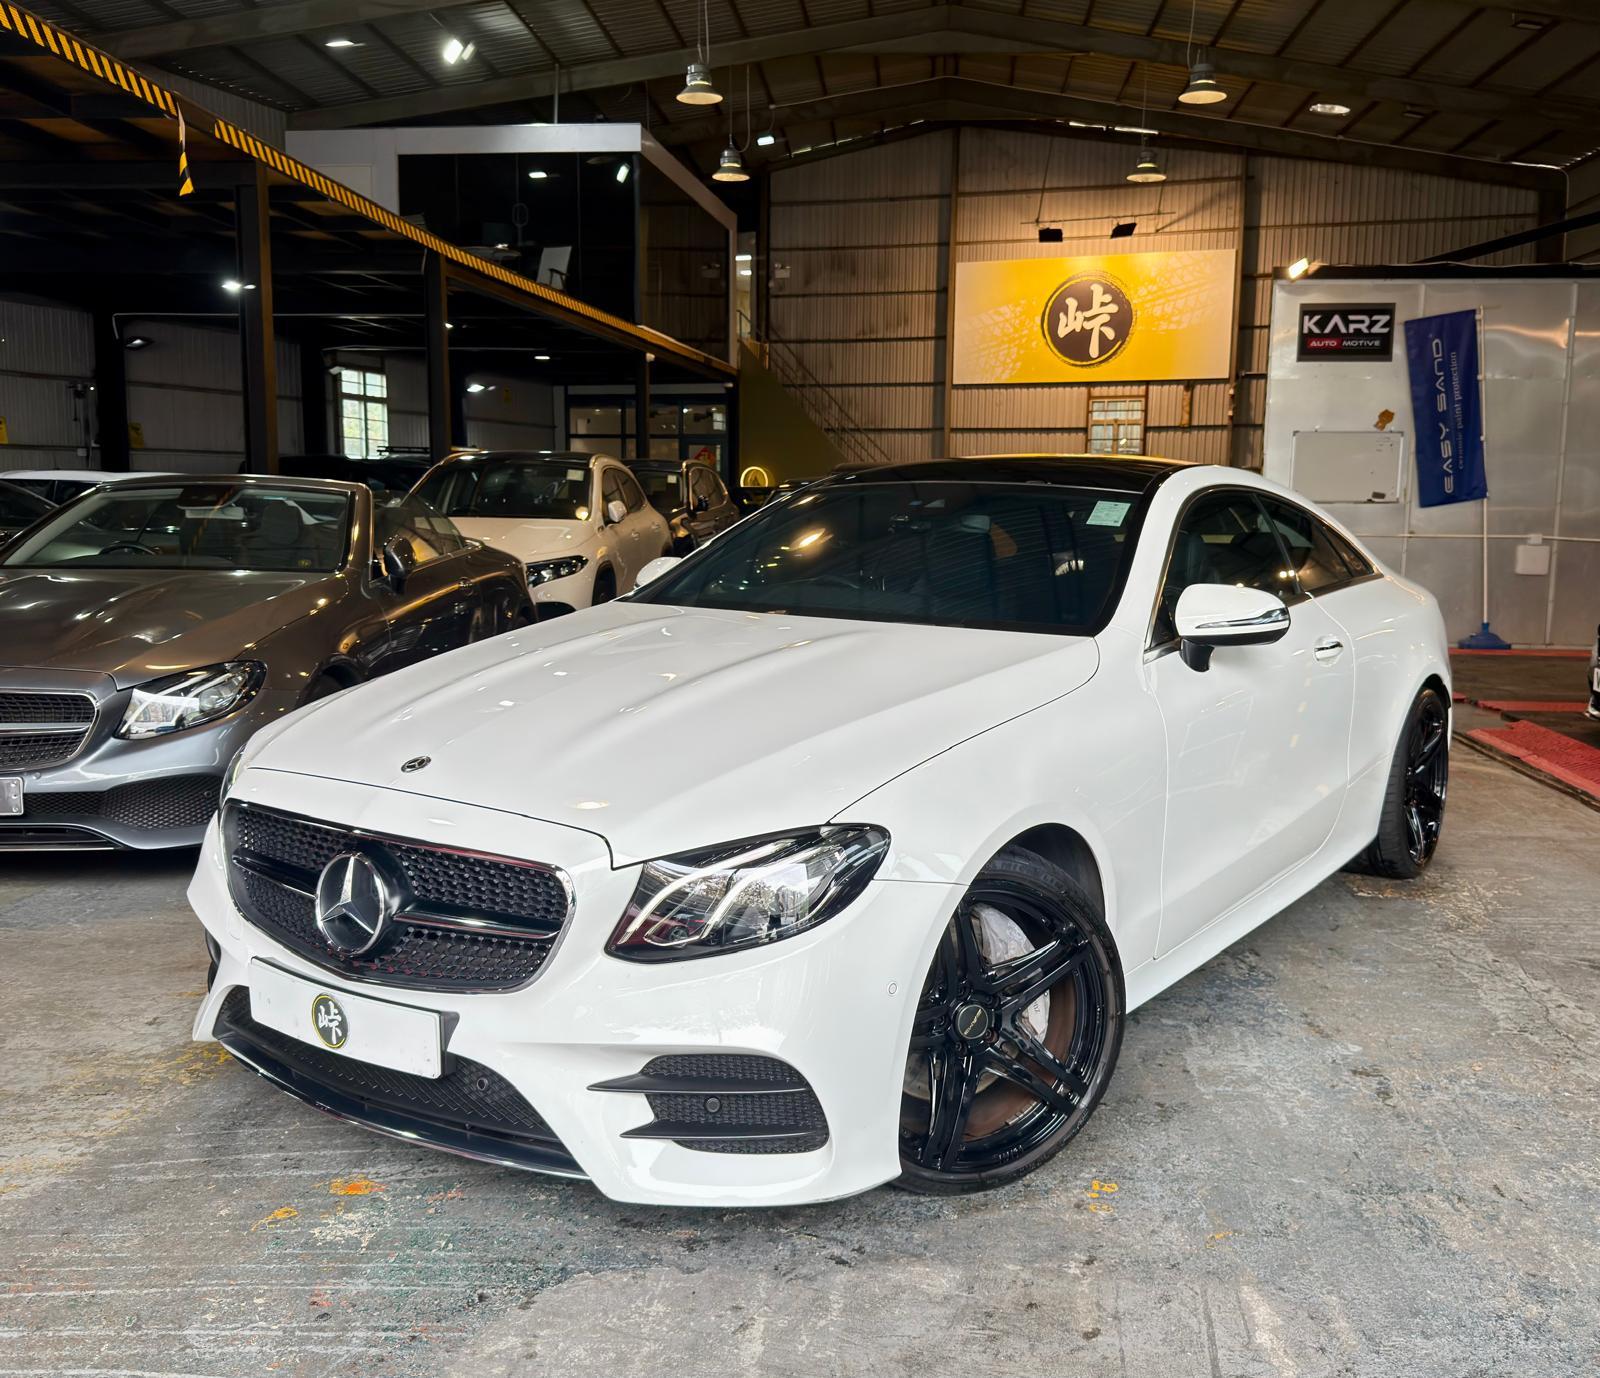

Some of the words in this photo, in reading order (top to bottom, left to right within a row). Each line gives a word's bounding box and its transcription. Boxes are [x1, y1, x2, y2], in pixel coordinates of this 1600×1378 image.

[1058, 284, 1119, 358] 峠
[1303, 314, 1390, 333] KARZ
[1432, 339, 1447, 412] SAND
[1450, 352, 1462, 400] protection
[1454, 402, 1463, 429] paint
[1439, 422, 1454, 494] EASY
[318, 1001, 342, 1044] 峠
